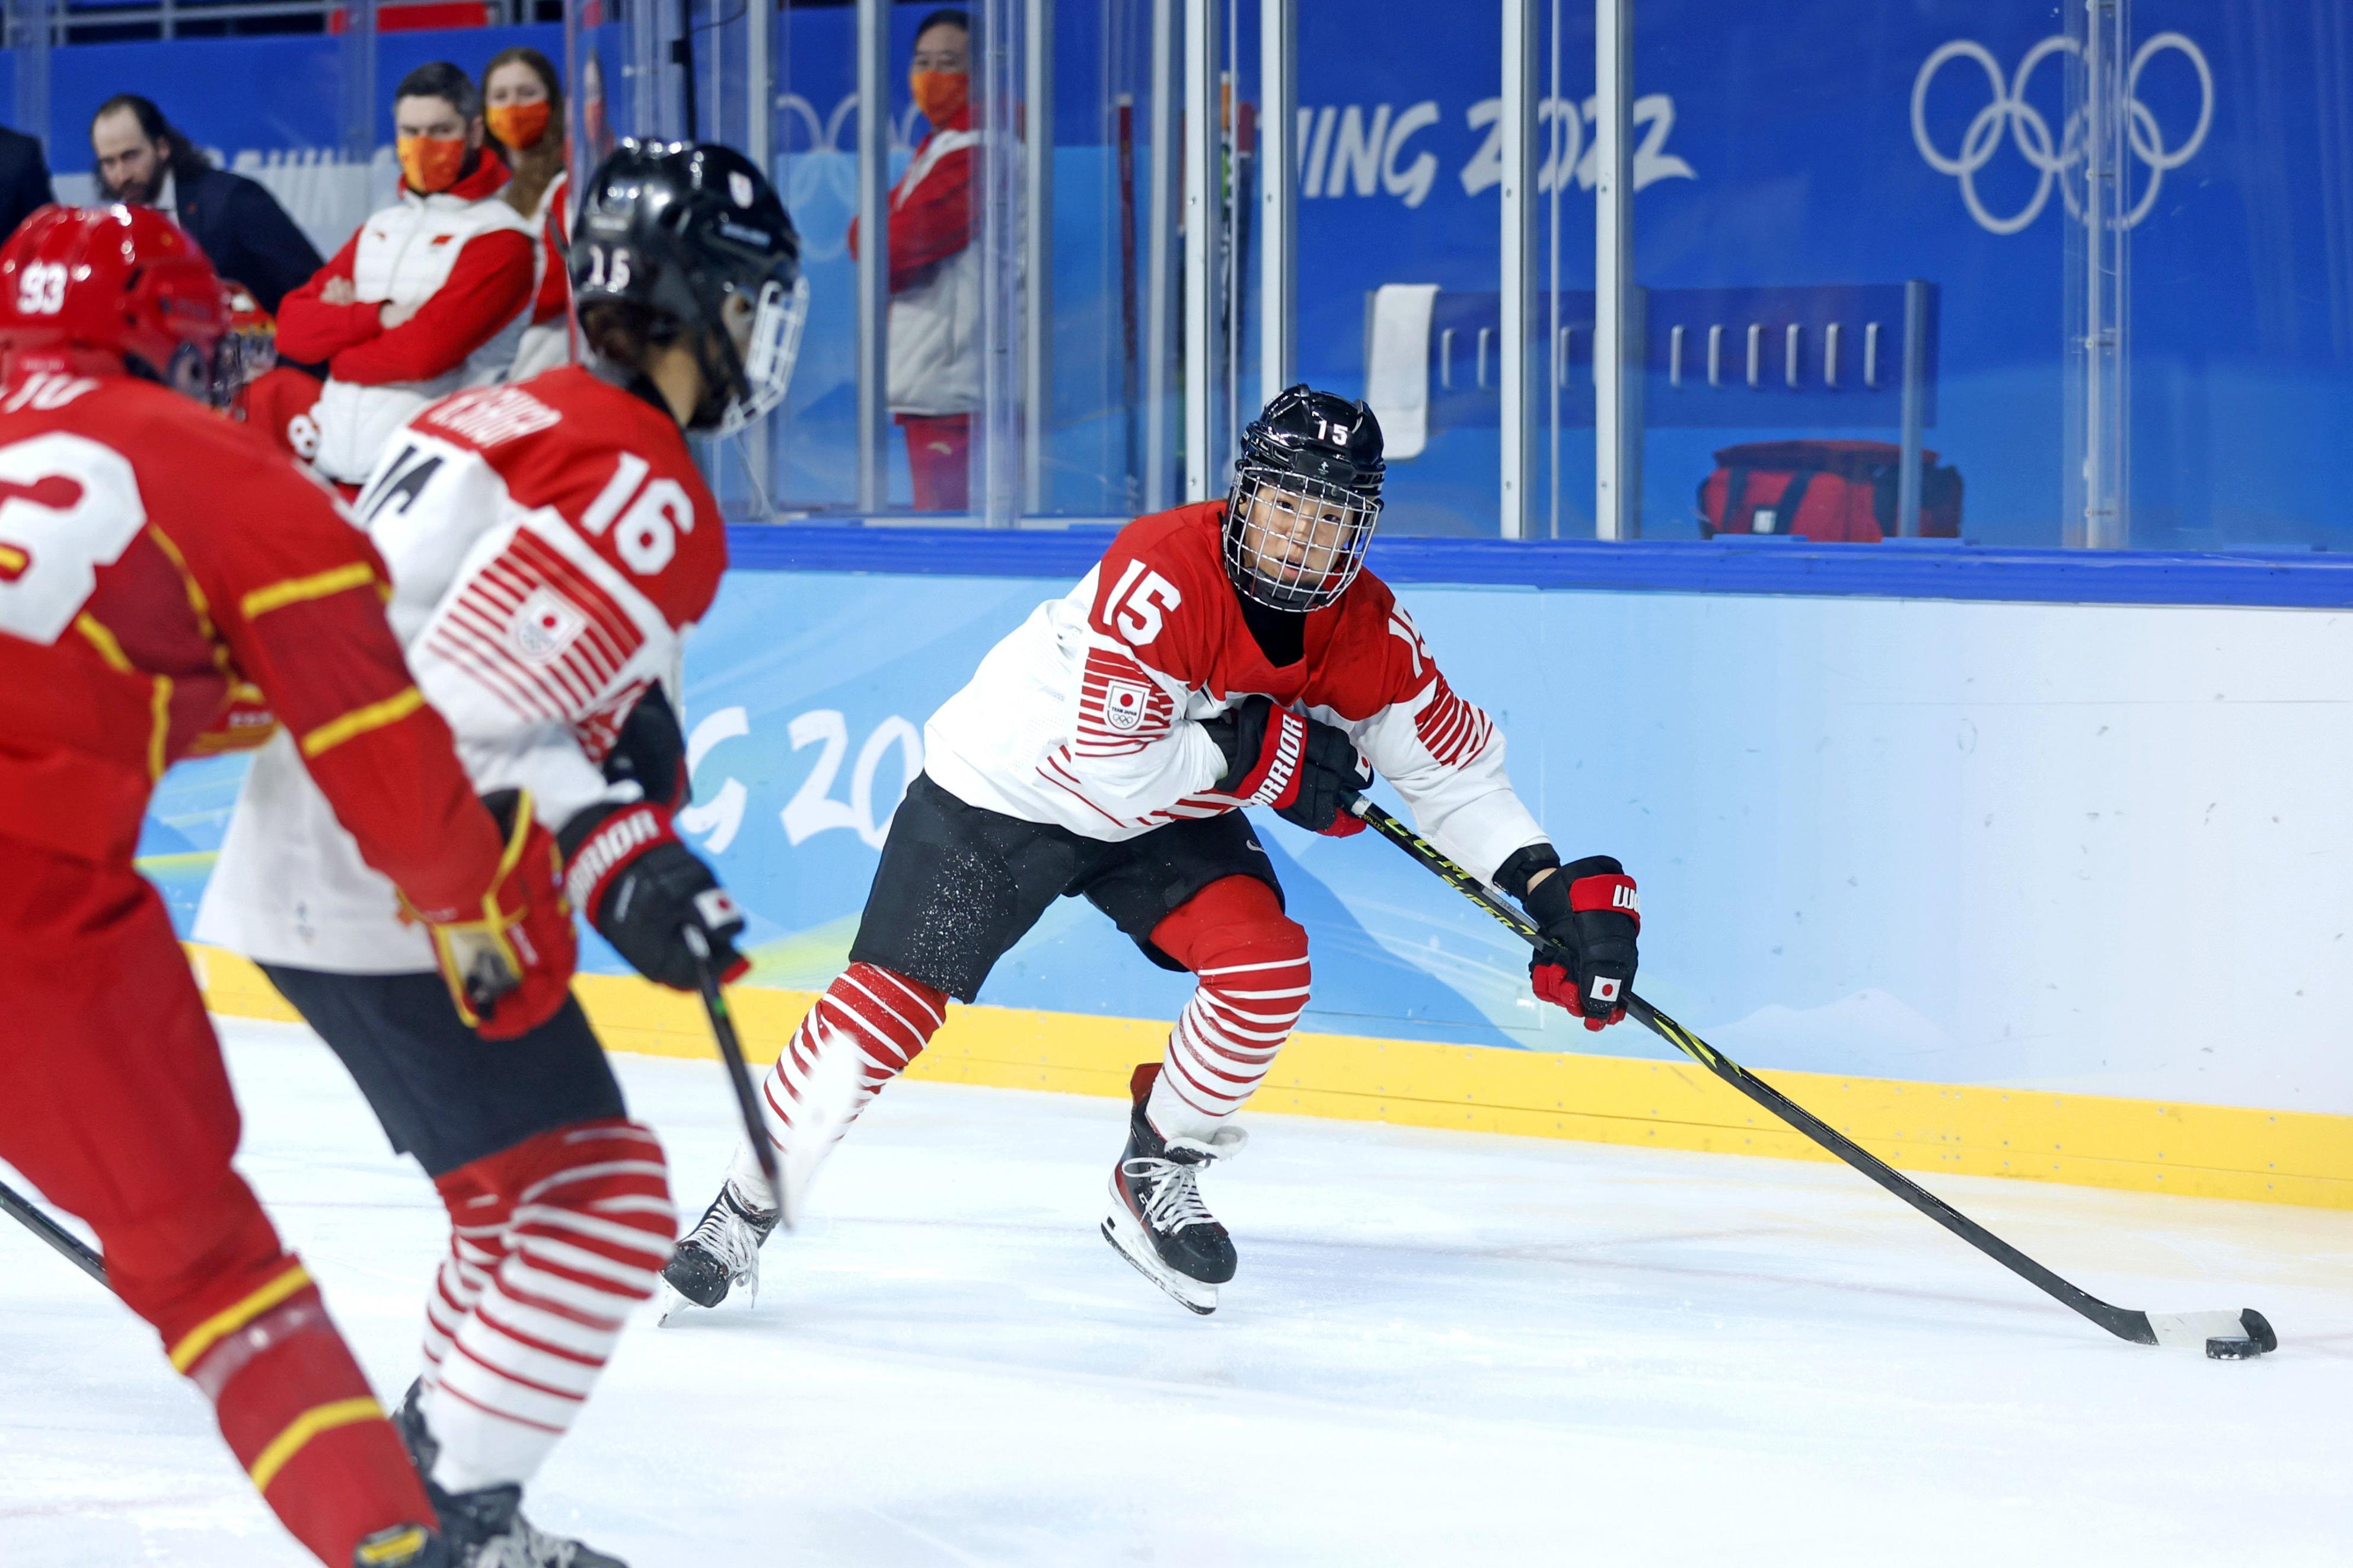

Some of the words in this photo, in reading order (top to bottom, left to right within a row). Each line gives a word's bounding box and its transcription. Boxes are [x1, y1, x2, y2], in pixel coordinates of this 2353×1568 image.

[17, 261, 68, 315] 93
[1318, 420, 1348, 446] 15
[581, 451, 694, 575] 16
[1102, 558, 1182, 646] 15
[1249, 714, 1303, 805] ARRIOR
[1440, 874, 1516, 929] SUPER
